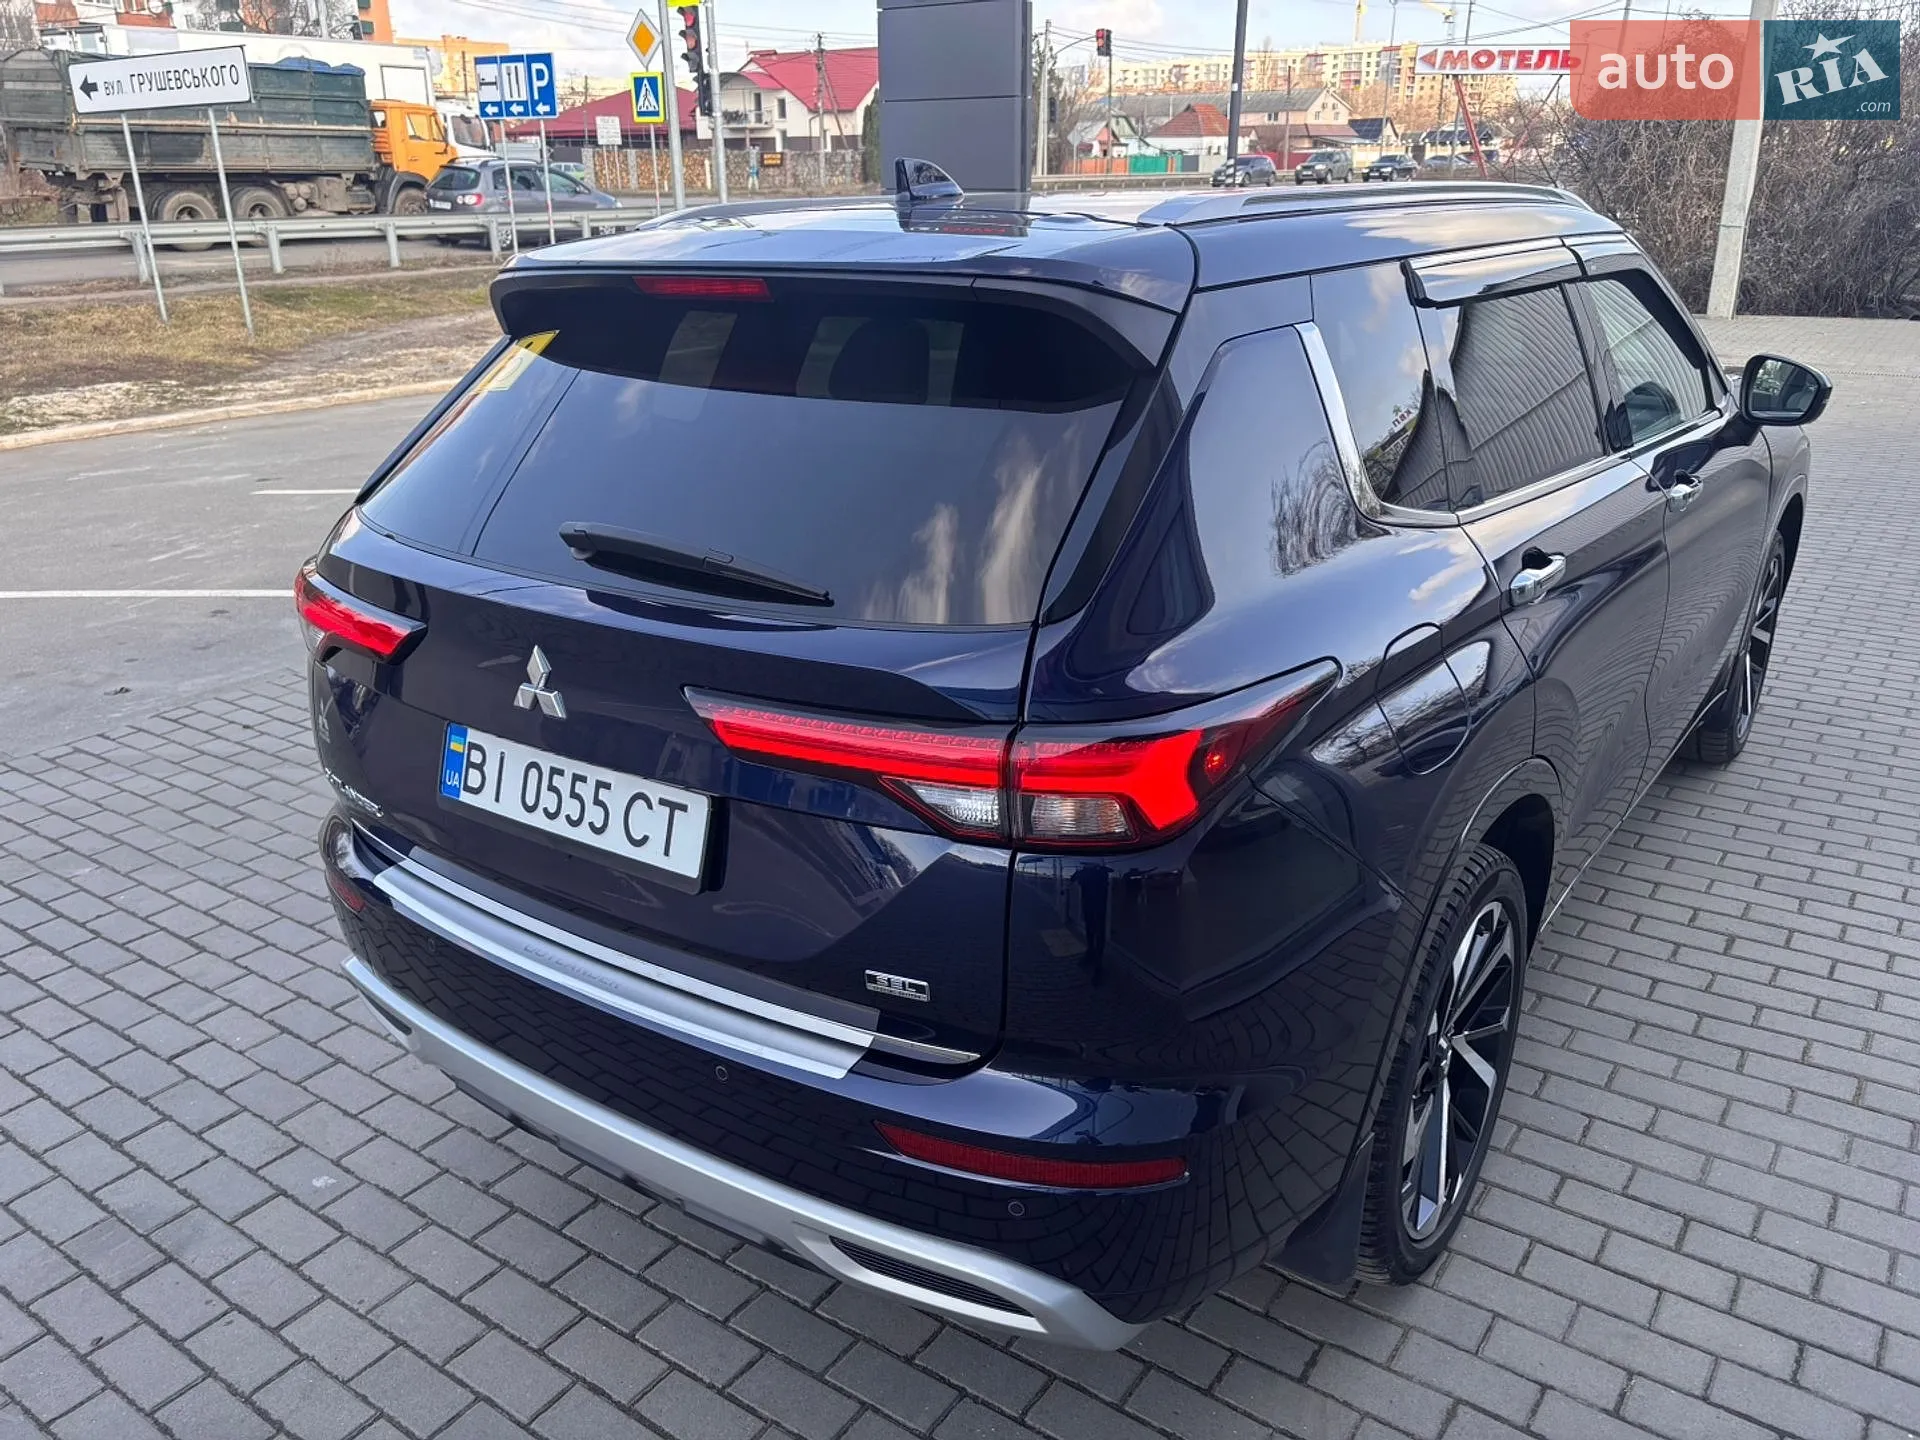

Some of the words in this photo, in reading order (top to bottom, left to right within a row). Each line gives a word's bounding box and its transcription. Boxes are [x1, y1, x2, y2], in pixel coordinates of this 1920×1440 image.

[1437, 48, 1582, 71] МОТЕЛЬ
[129, 64, 240, 94] ГРУШЕВСЬКОГО
[445, 769, 460, 789] UA
[520, 761, 612, 836] 0555
[623, 791, 689, 857] CT
